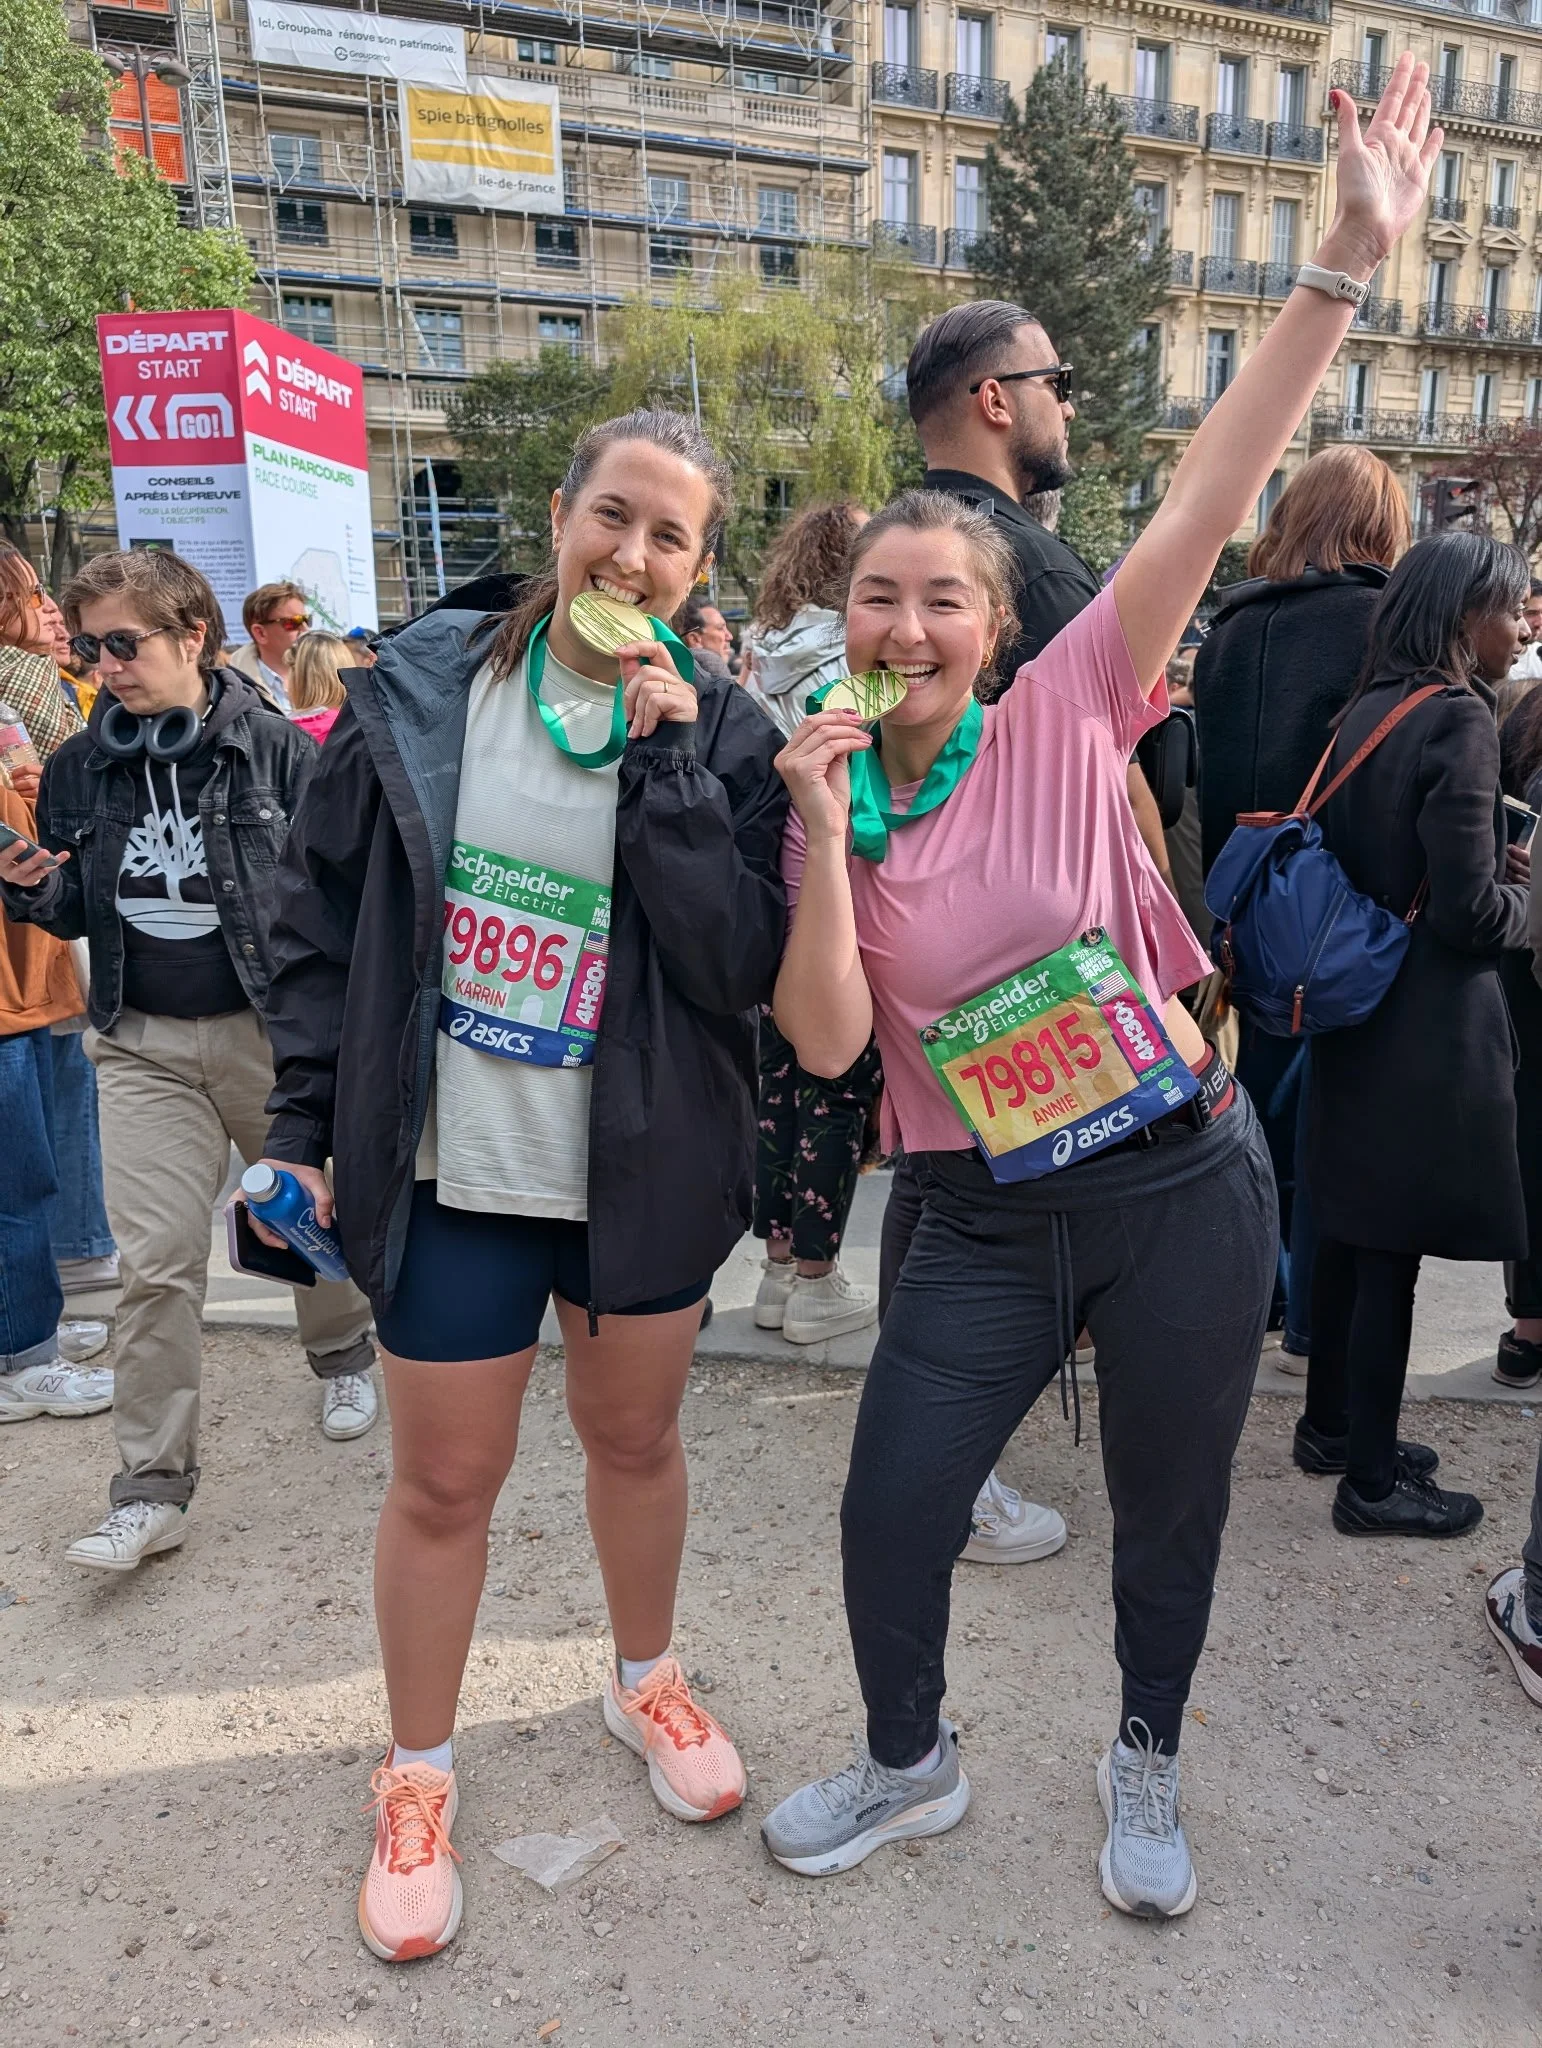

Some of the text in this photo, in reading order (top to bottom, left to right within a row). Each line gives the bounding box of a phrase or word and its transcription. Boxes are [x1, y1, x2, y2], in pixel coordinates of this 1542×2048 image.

[258, 17, 275, 30] Ici,
[277, 20, 332, 37] Groupama
[338, 29, 375, 42] rénove
[378, 35, 396, 46] son
[349, 49, 391, 62] Groupama
[417, 107, 545, 135] spie batignolles
[105, 329, 229, 355] DÉPART
[137, 358, 203, 380] START
[276, 354, 353, 409] DÉPART
[278, 387, 318, 423] START
[180, 413, 221, 439] GO!
[147, 476, 215, 487] CONSEILS
[252, 443, 355, 488] PLAN PARCOURS
[255, 467, 319, 500] RACE COURSE
[451, 845, 576, 902] Schneider
[493, 883, 566, 917] Electric
[1083, 954, 1114, 981] PARIS
[455, 977, 507, 1009] KARRIN
[575, 959, 608, 1025] 4H30+
[937, 969, 1052, 1039] Schneider
[991, 988, 1061, 1033] Electric
[1113, 1000, 1156, 1060] 4H30+
[959, 1011, 1102, 1119] 79815
[1139, 1057, 1175, 1083] 2026
[1032, 1093, 1079, 1127] ANNIE
[36, 1375, 64, 1393] N
[855, 1797, 890, 1823] BROOKS
